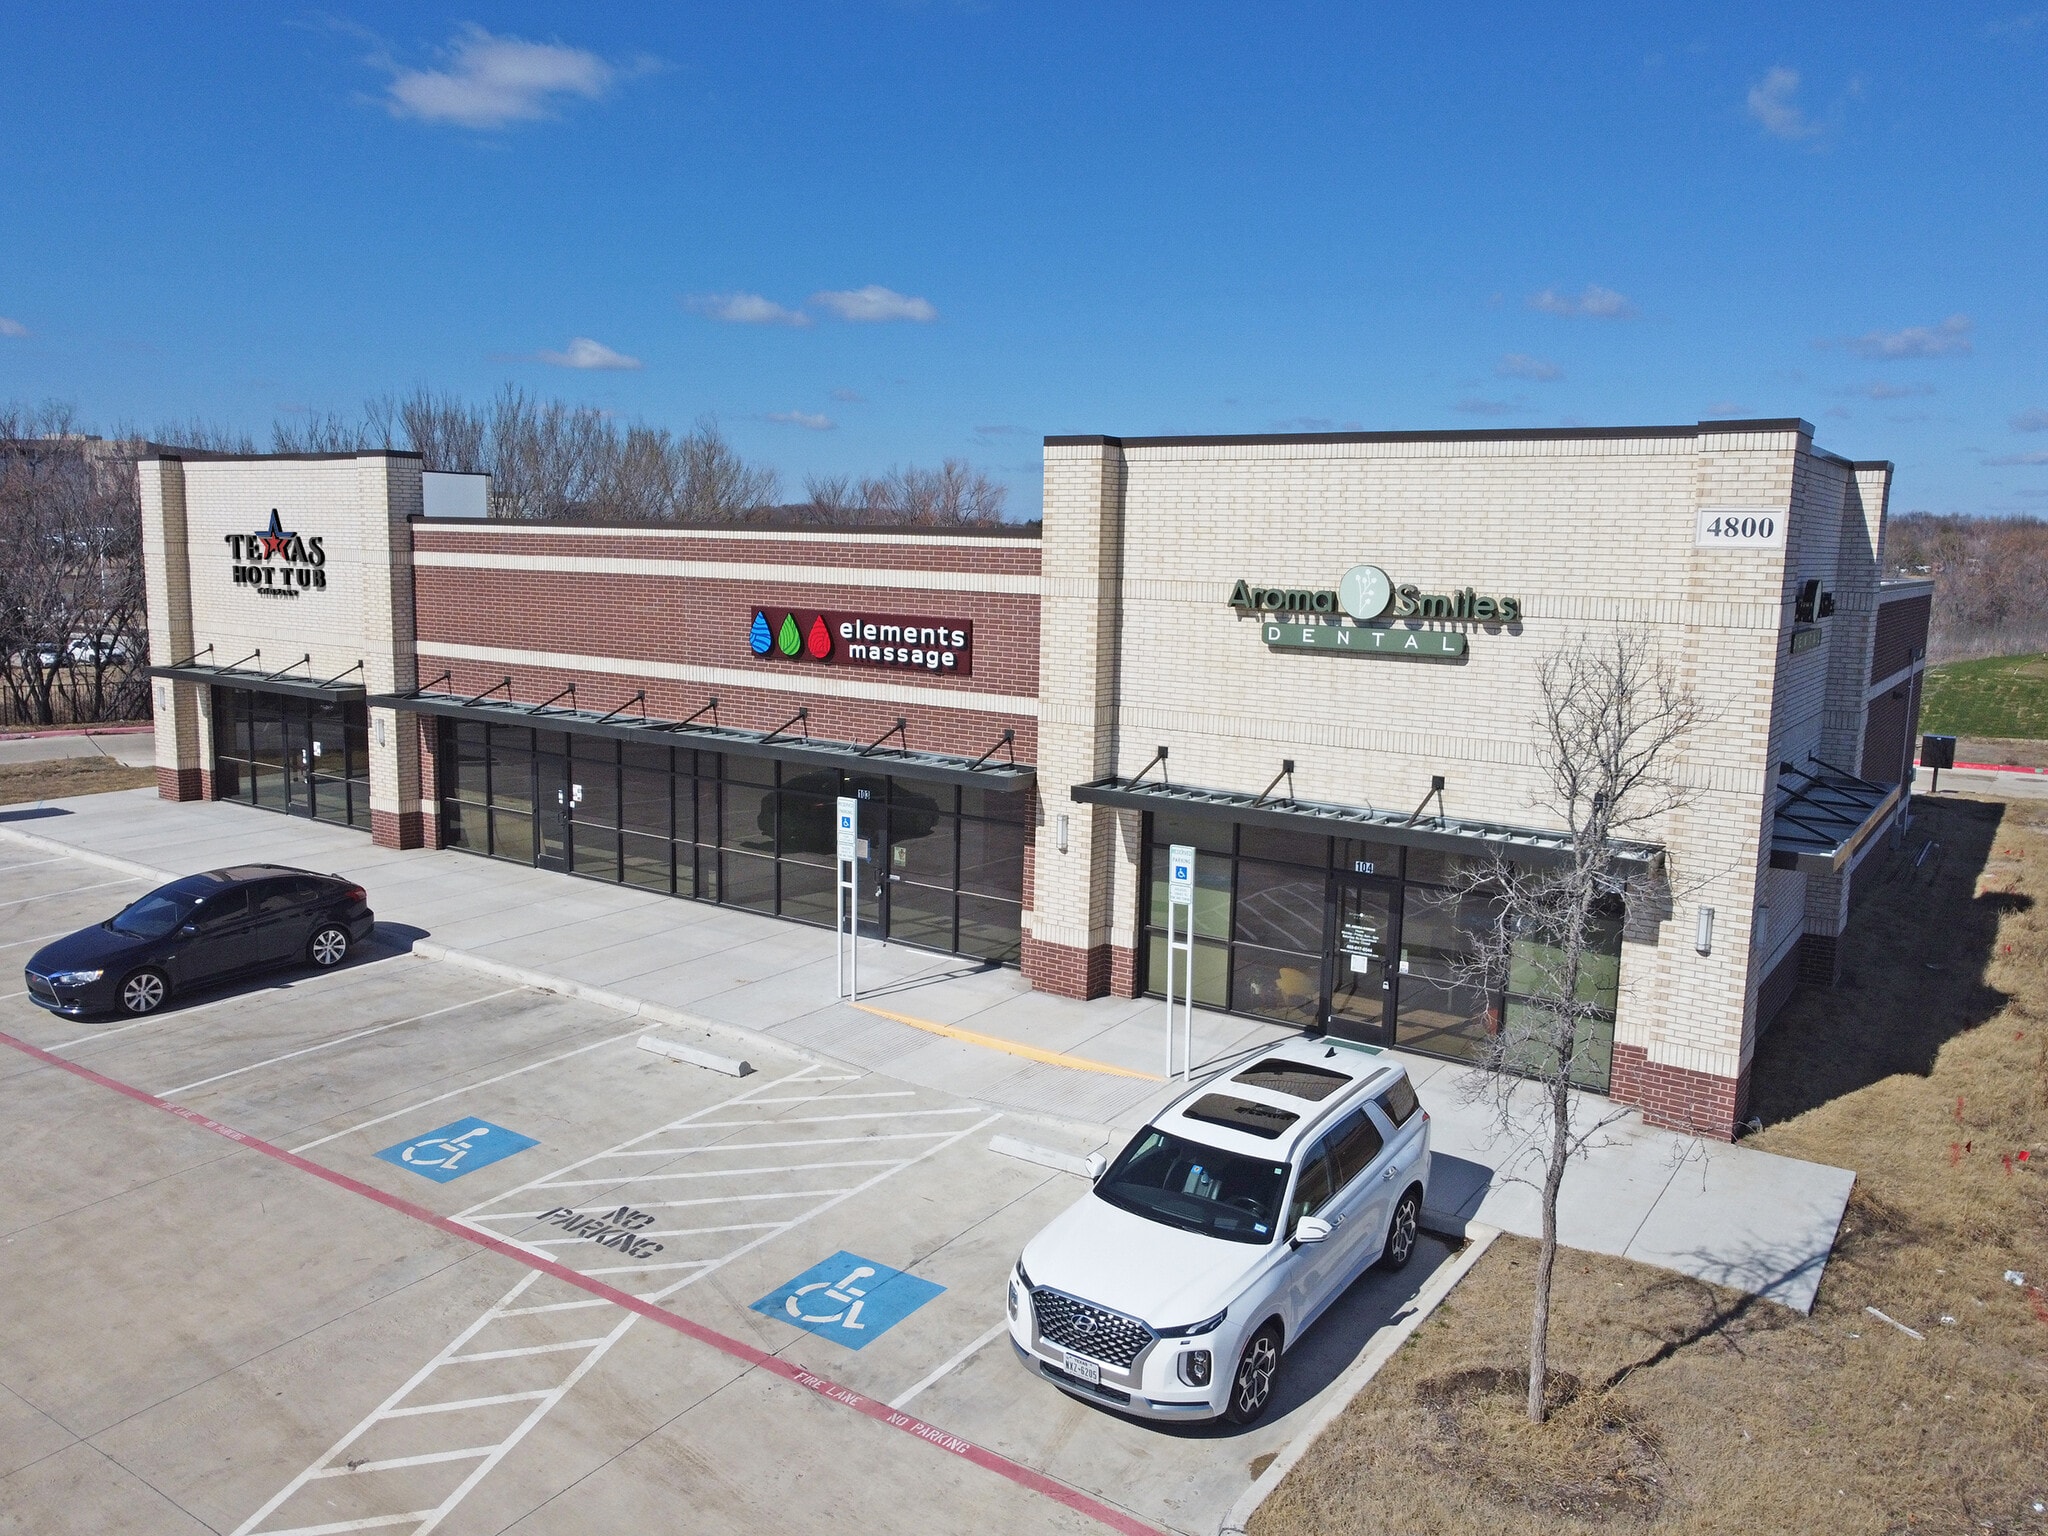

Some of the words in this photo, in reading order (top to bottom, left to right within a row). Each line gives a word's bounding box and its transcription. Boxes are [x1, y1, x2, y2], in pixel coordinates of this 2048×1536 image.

[1707, 517, 1774, 538] 4800
[232, 565, 275, 585] HOT
[280, 567, 326, 588] TUB
[1227, 579, 1338, 613] Aroma
[1395, 583, 1522, 622] Smiles
[840, 619, 965, 647] elements
[1268, 626, 1456, 652] DENTAL
[849, 644, 954, 669] massage
[857, 789, 871, 800] 103
[1356, 861, 1373, 874] 104
[601, 1206, 655, 1230] NO
[536, 1207, 664, 1258] PARKING
[794, 1372, 827, 1390] FIRE
[826, 1386, 862, 1407] LANE
[887, 1412, 909, 1426] NO
[912, 1422, 970, 1454] PARKING
